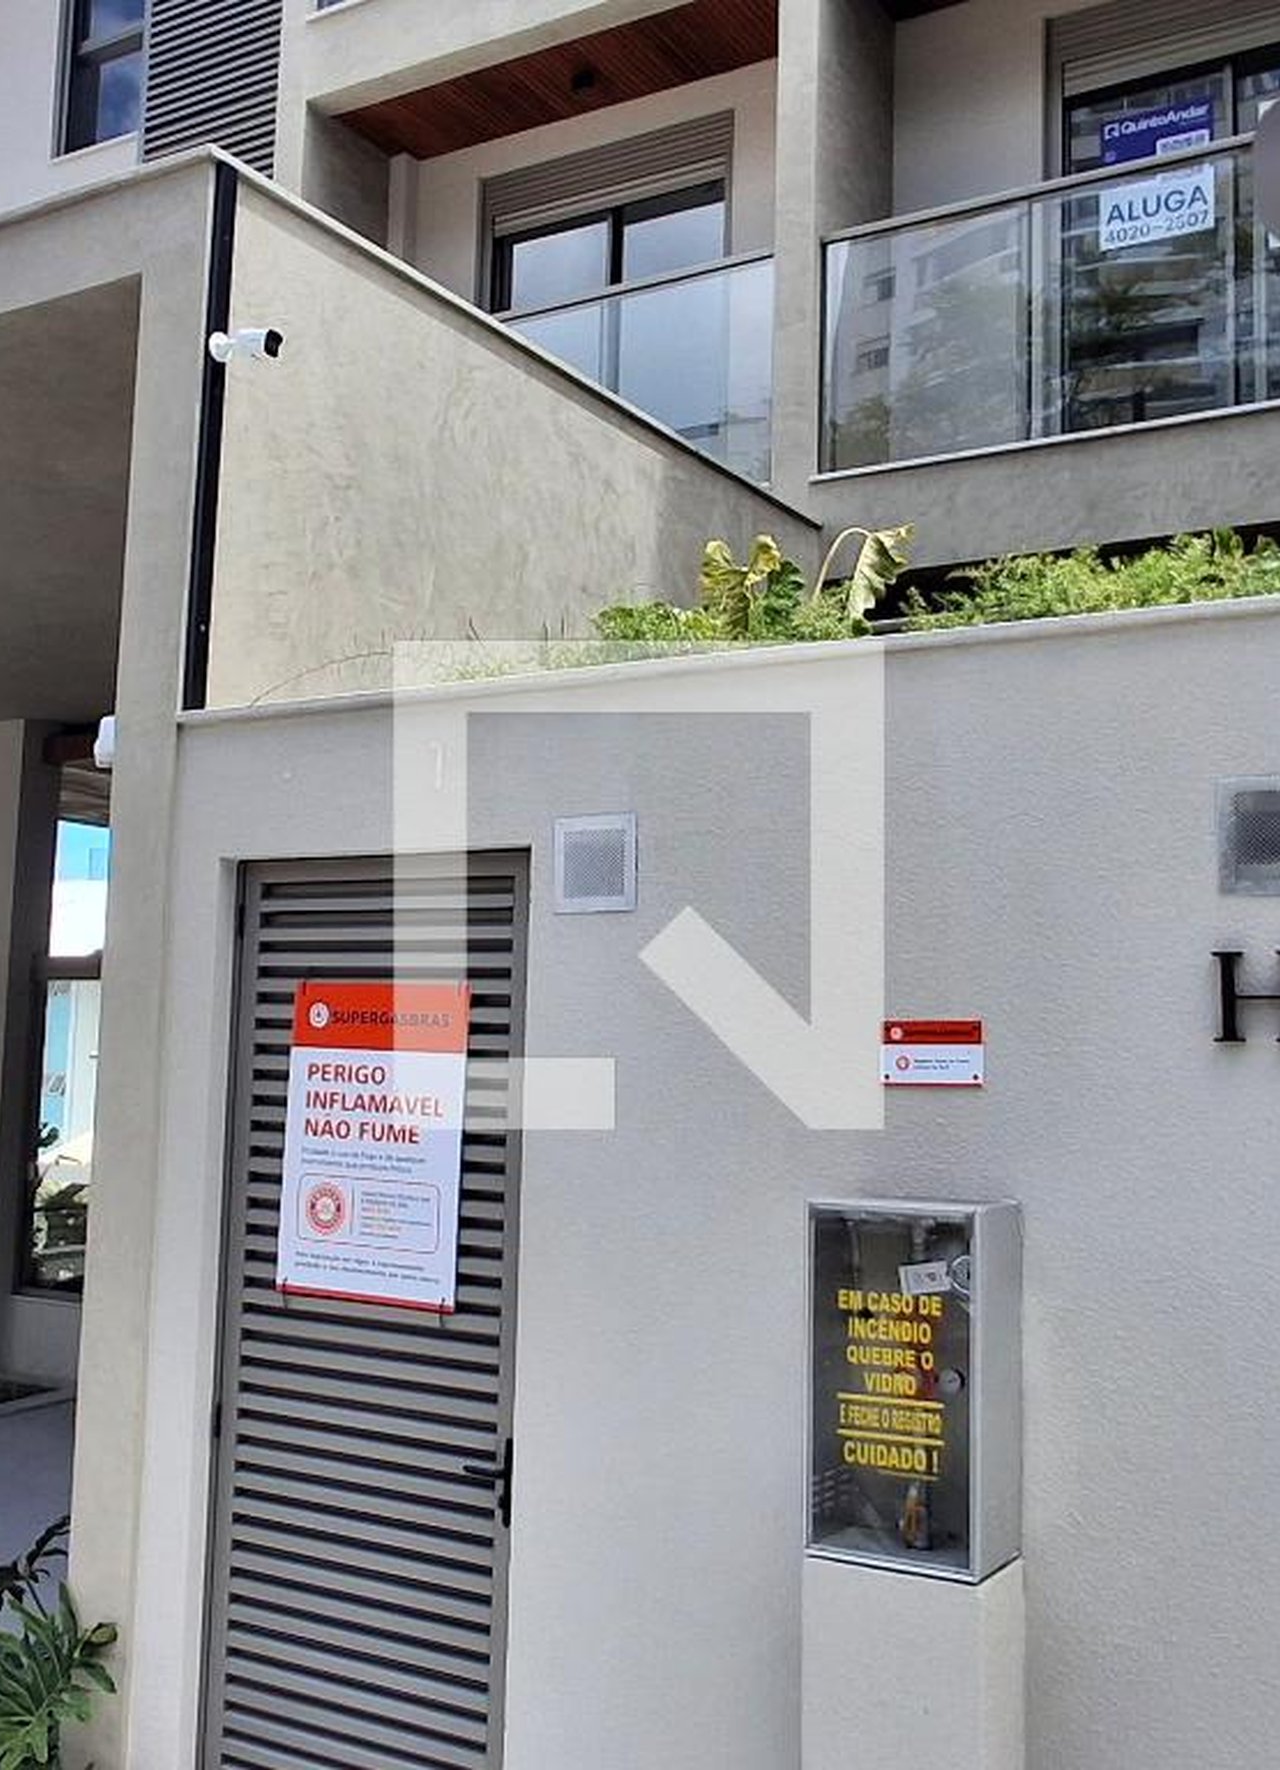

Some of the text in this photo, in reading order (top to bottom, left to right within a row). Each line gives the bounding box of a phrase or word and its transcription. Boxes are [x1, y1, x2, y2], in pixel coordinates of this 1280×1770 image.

[1107, 186, 1208, 226] ALUGA
[331, 1009, 451, 1028] SUPERGASBRAS
[307, 1063, 386, 1086] PERIGO
[358, 1121, 420, 1144] FUME
[837, 1289, 942, 1317] EM CASO DE
[846, 1345, 934, 1370] QUEBRE O
[864, 1371, 917, 1396] VIDRO
[844, 1440, 928, 1472] CUIDADO
